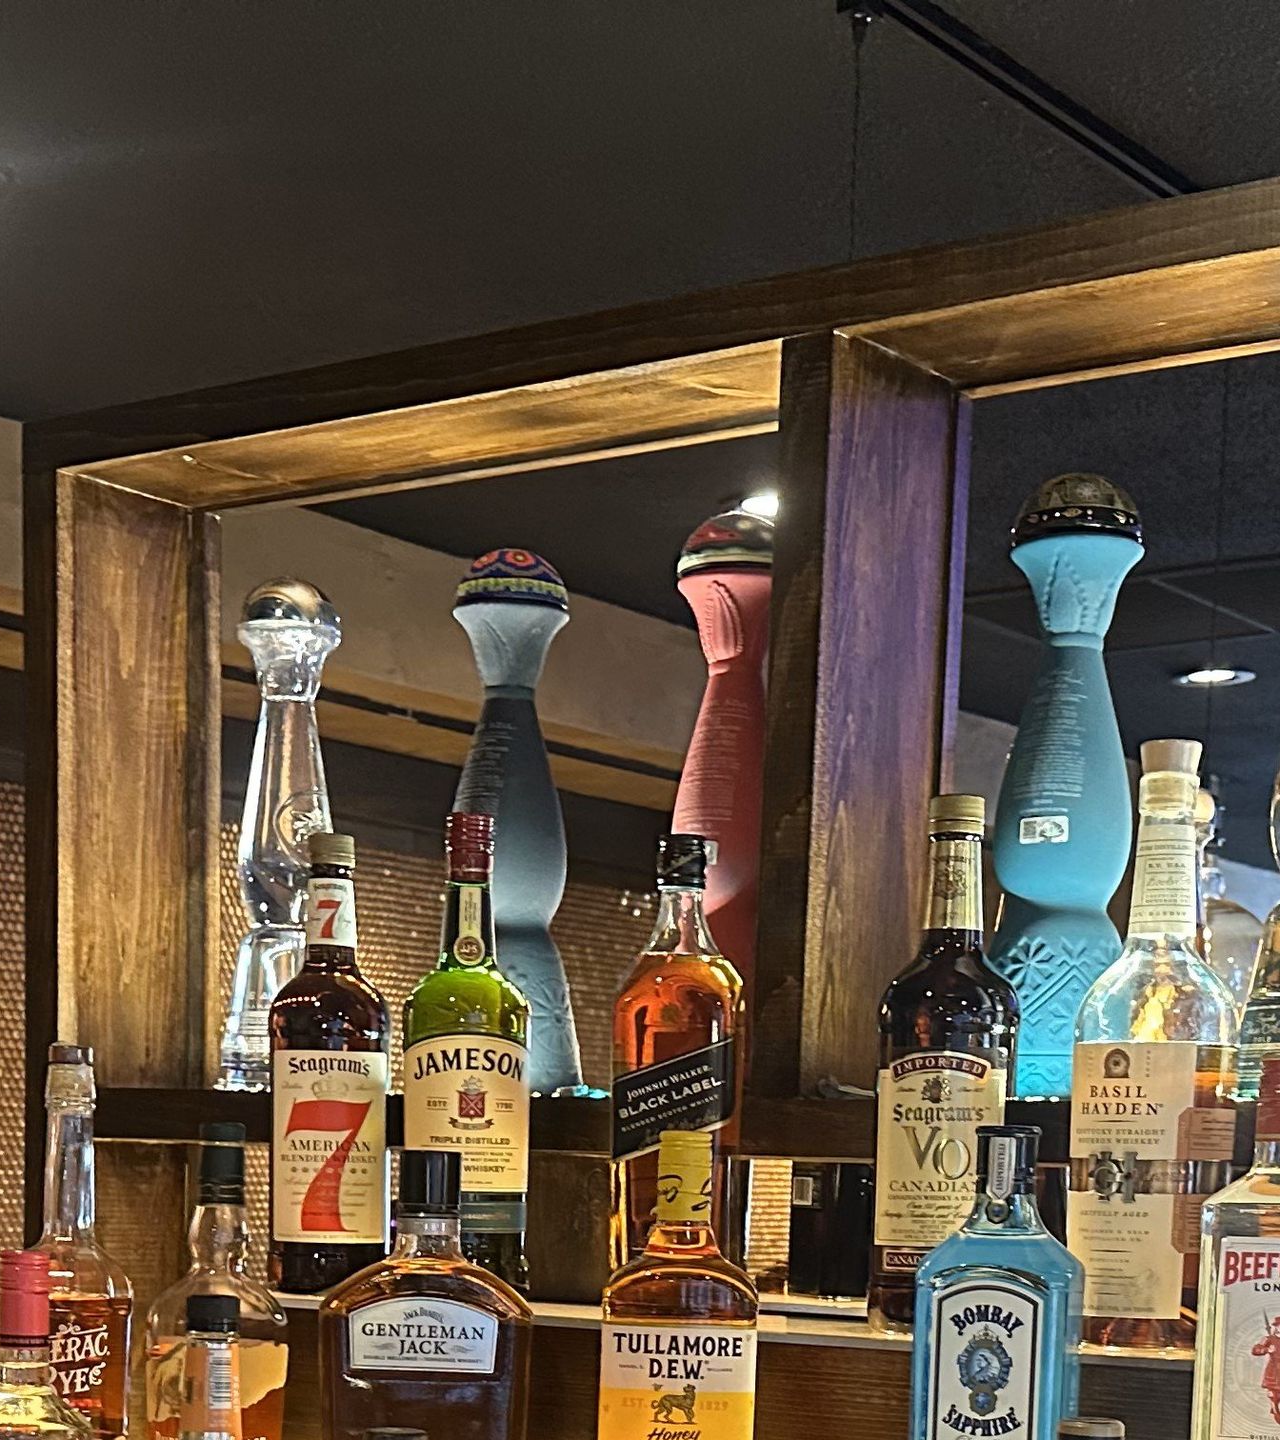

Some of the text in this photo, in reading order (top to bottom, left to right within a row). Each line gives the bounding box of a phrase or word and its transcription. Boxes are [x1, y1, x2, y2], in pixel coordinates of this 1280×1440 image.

[316, 899, 342, 938] 7
[288, 1057, 370, 1077] Seagram's
[414, 1048, 524, 1083] JAMESON
[896, 1057, 983, 1076] IMPORTED
[627, 1065, 711, 1102] JOHNNIE WALKER
[1089, 1085, 1147, 1099] BASIL
[619, 1076, 722, 1119] BLACK LABEL
[893, 1103, 985, 1125] Seagram's
[1081, 1102, 1158, 1115] HAYDEN
[429, 1135, 510, 1146] TRIPLE DISTILLED
[1116, 1128, 1165, 1136] STRAIGHT
[1116, 1137, 1160, 1145] WHISKEY
[289, 1139, 372, 1152] AMERICAN
[284, 1098, 372, 1232] 7
[950, 1304, 1024, 1337] BOMBAY
[361, 1323, 485, 1340] GENTLEMAN
[50, 1332, 110, 1363] ERAC.
[399, 1340, 448, 1356] JACK
[613, 1332, 743, 1357] TULLAMORE
[649, 1358, 705, 1380] D.E.W.
[699, 1399, 729, 1411] 1829
[942, 1404, 1022, 1437] SAPPHIRE
